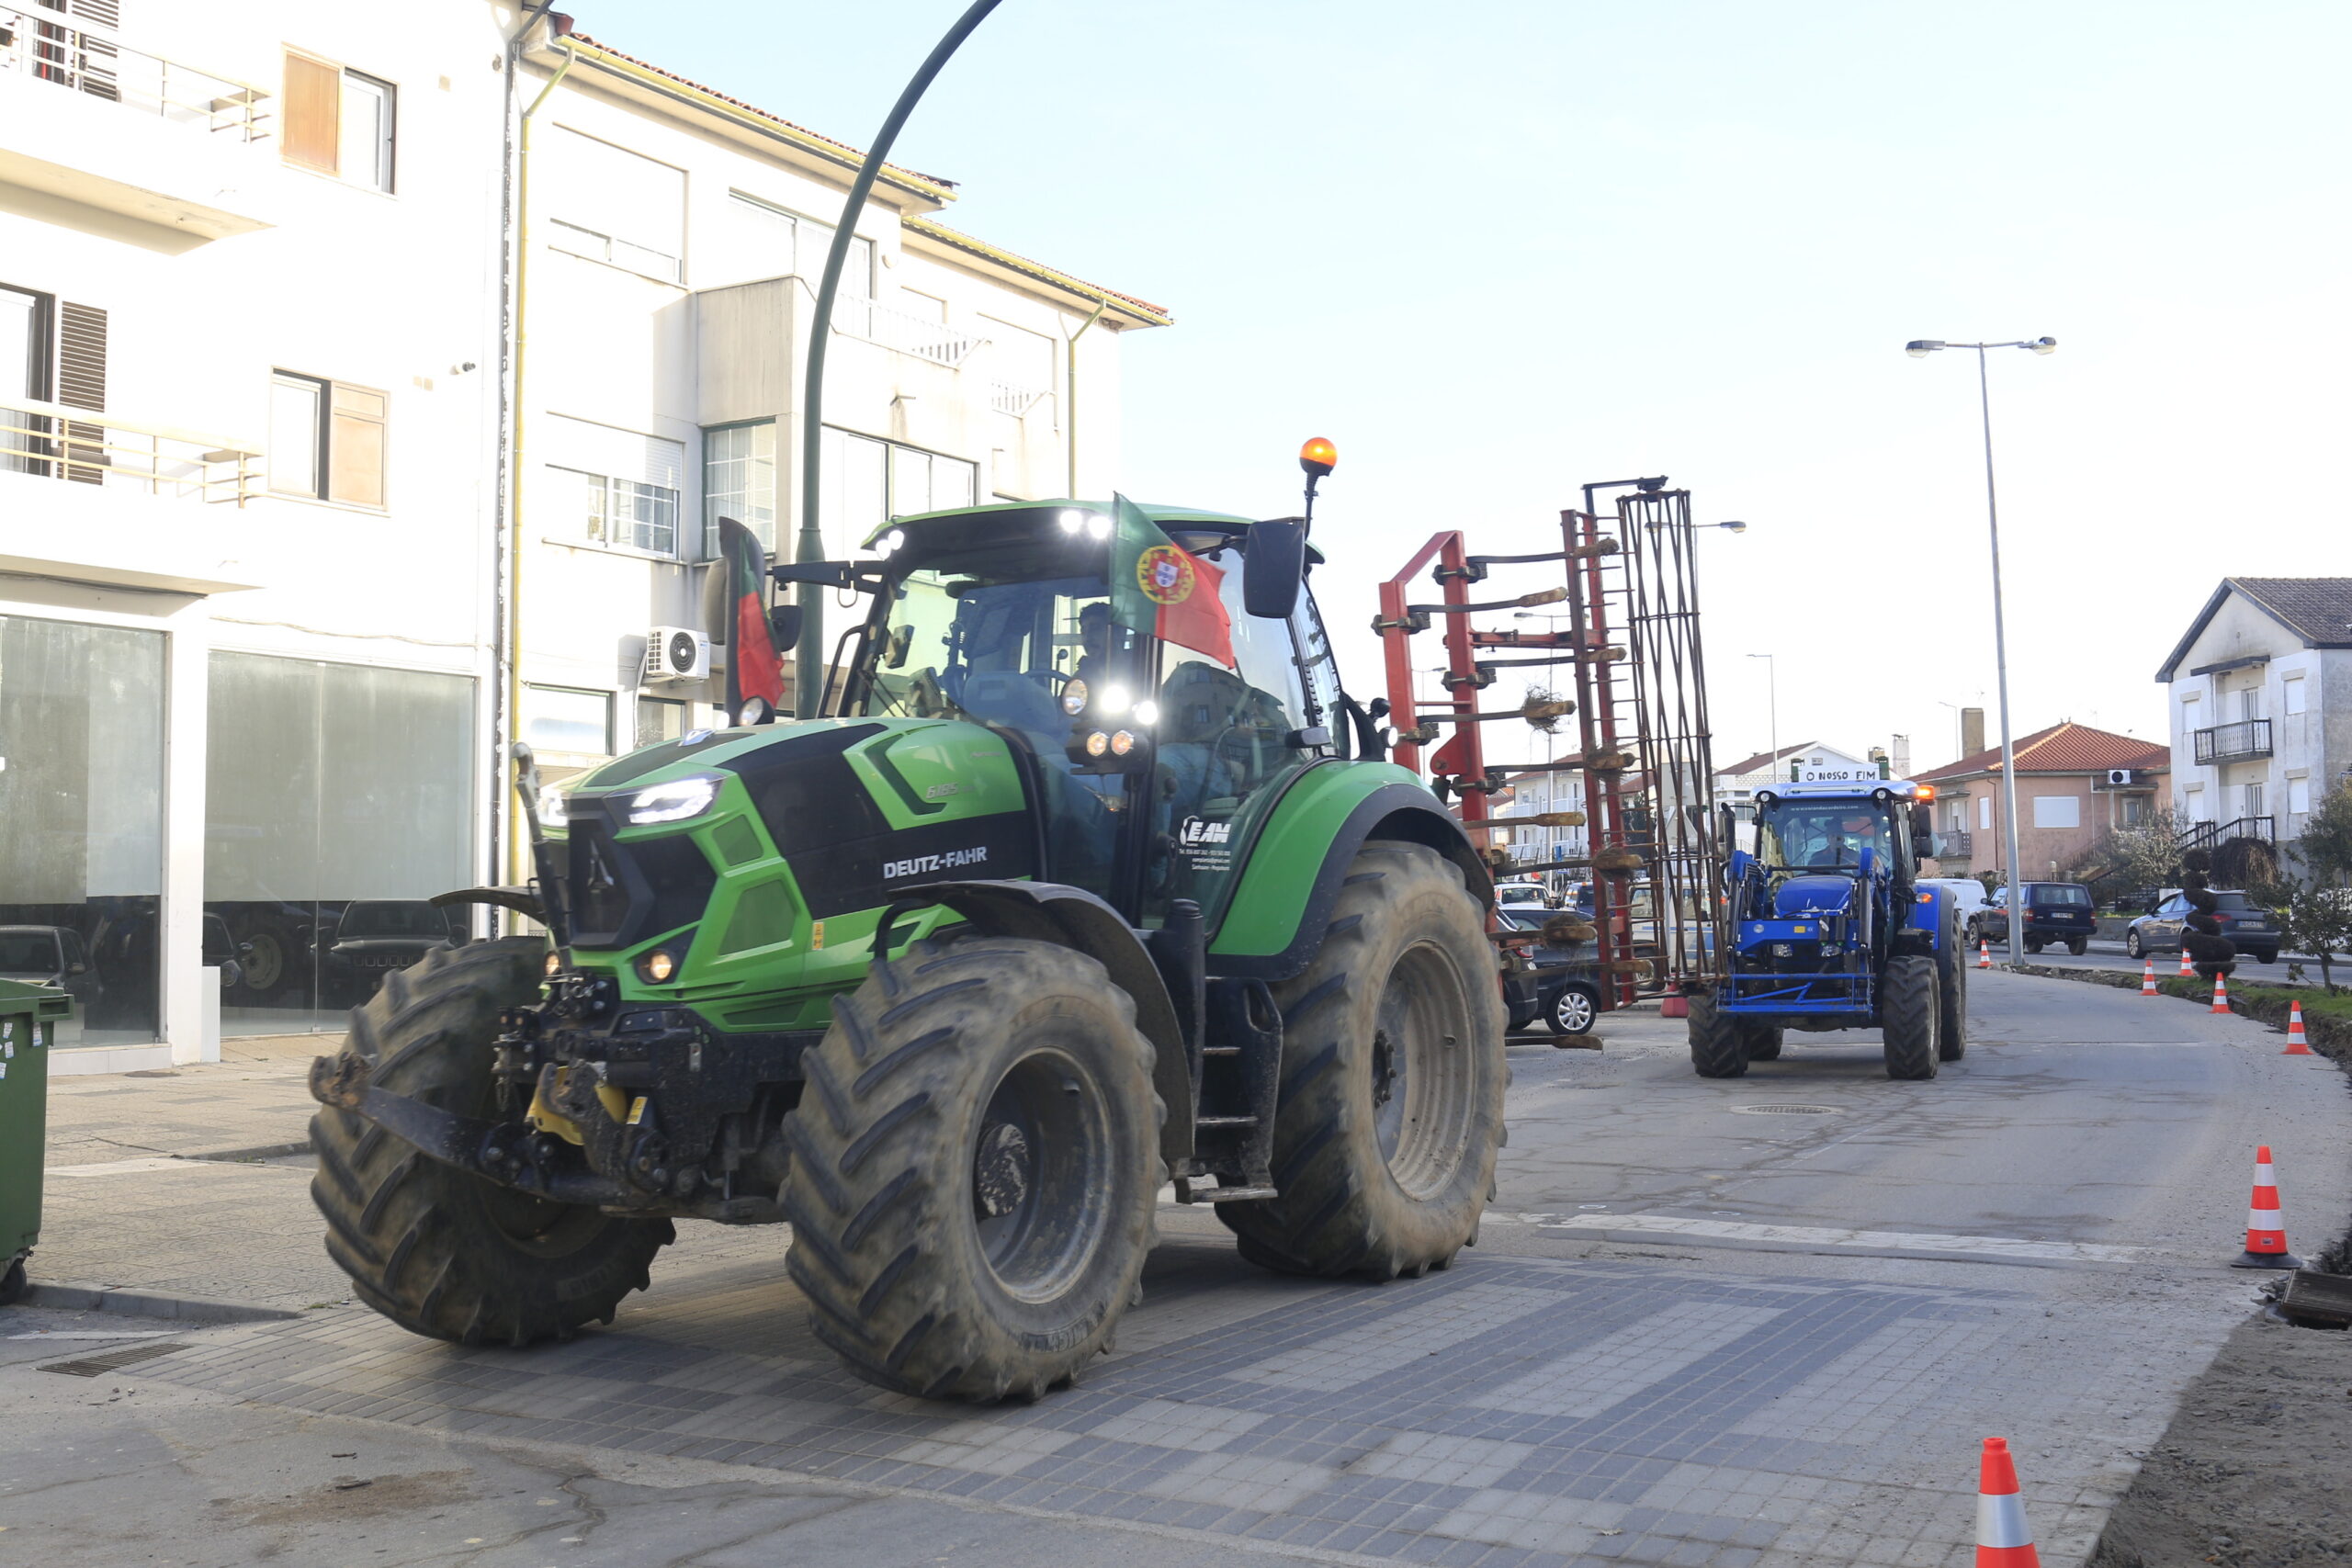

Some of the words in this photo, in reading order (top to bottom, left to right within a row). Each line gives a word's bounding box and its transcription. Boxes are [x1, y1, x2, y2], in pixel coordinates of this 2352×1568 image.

[1806, 772, 1815, 781] O
[1818, 772, 1849, 780] NOSSO
[1856, 772, 1876, 780] FIM
[1186, 821, 1232, 843] EAM
[883, 846, 988, 879] DEUTZ-FAHR
